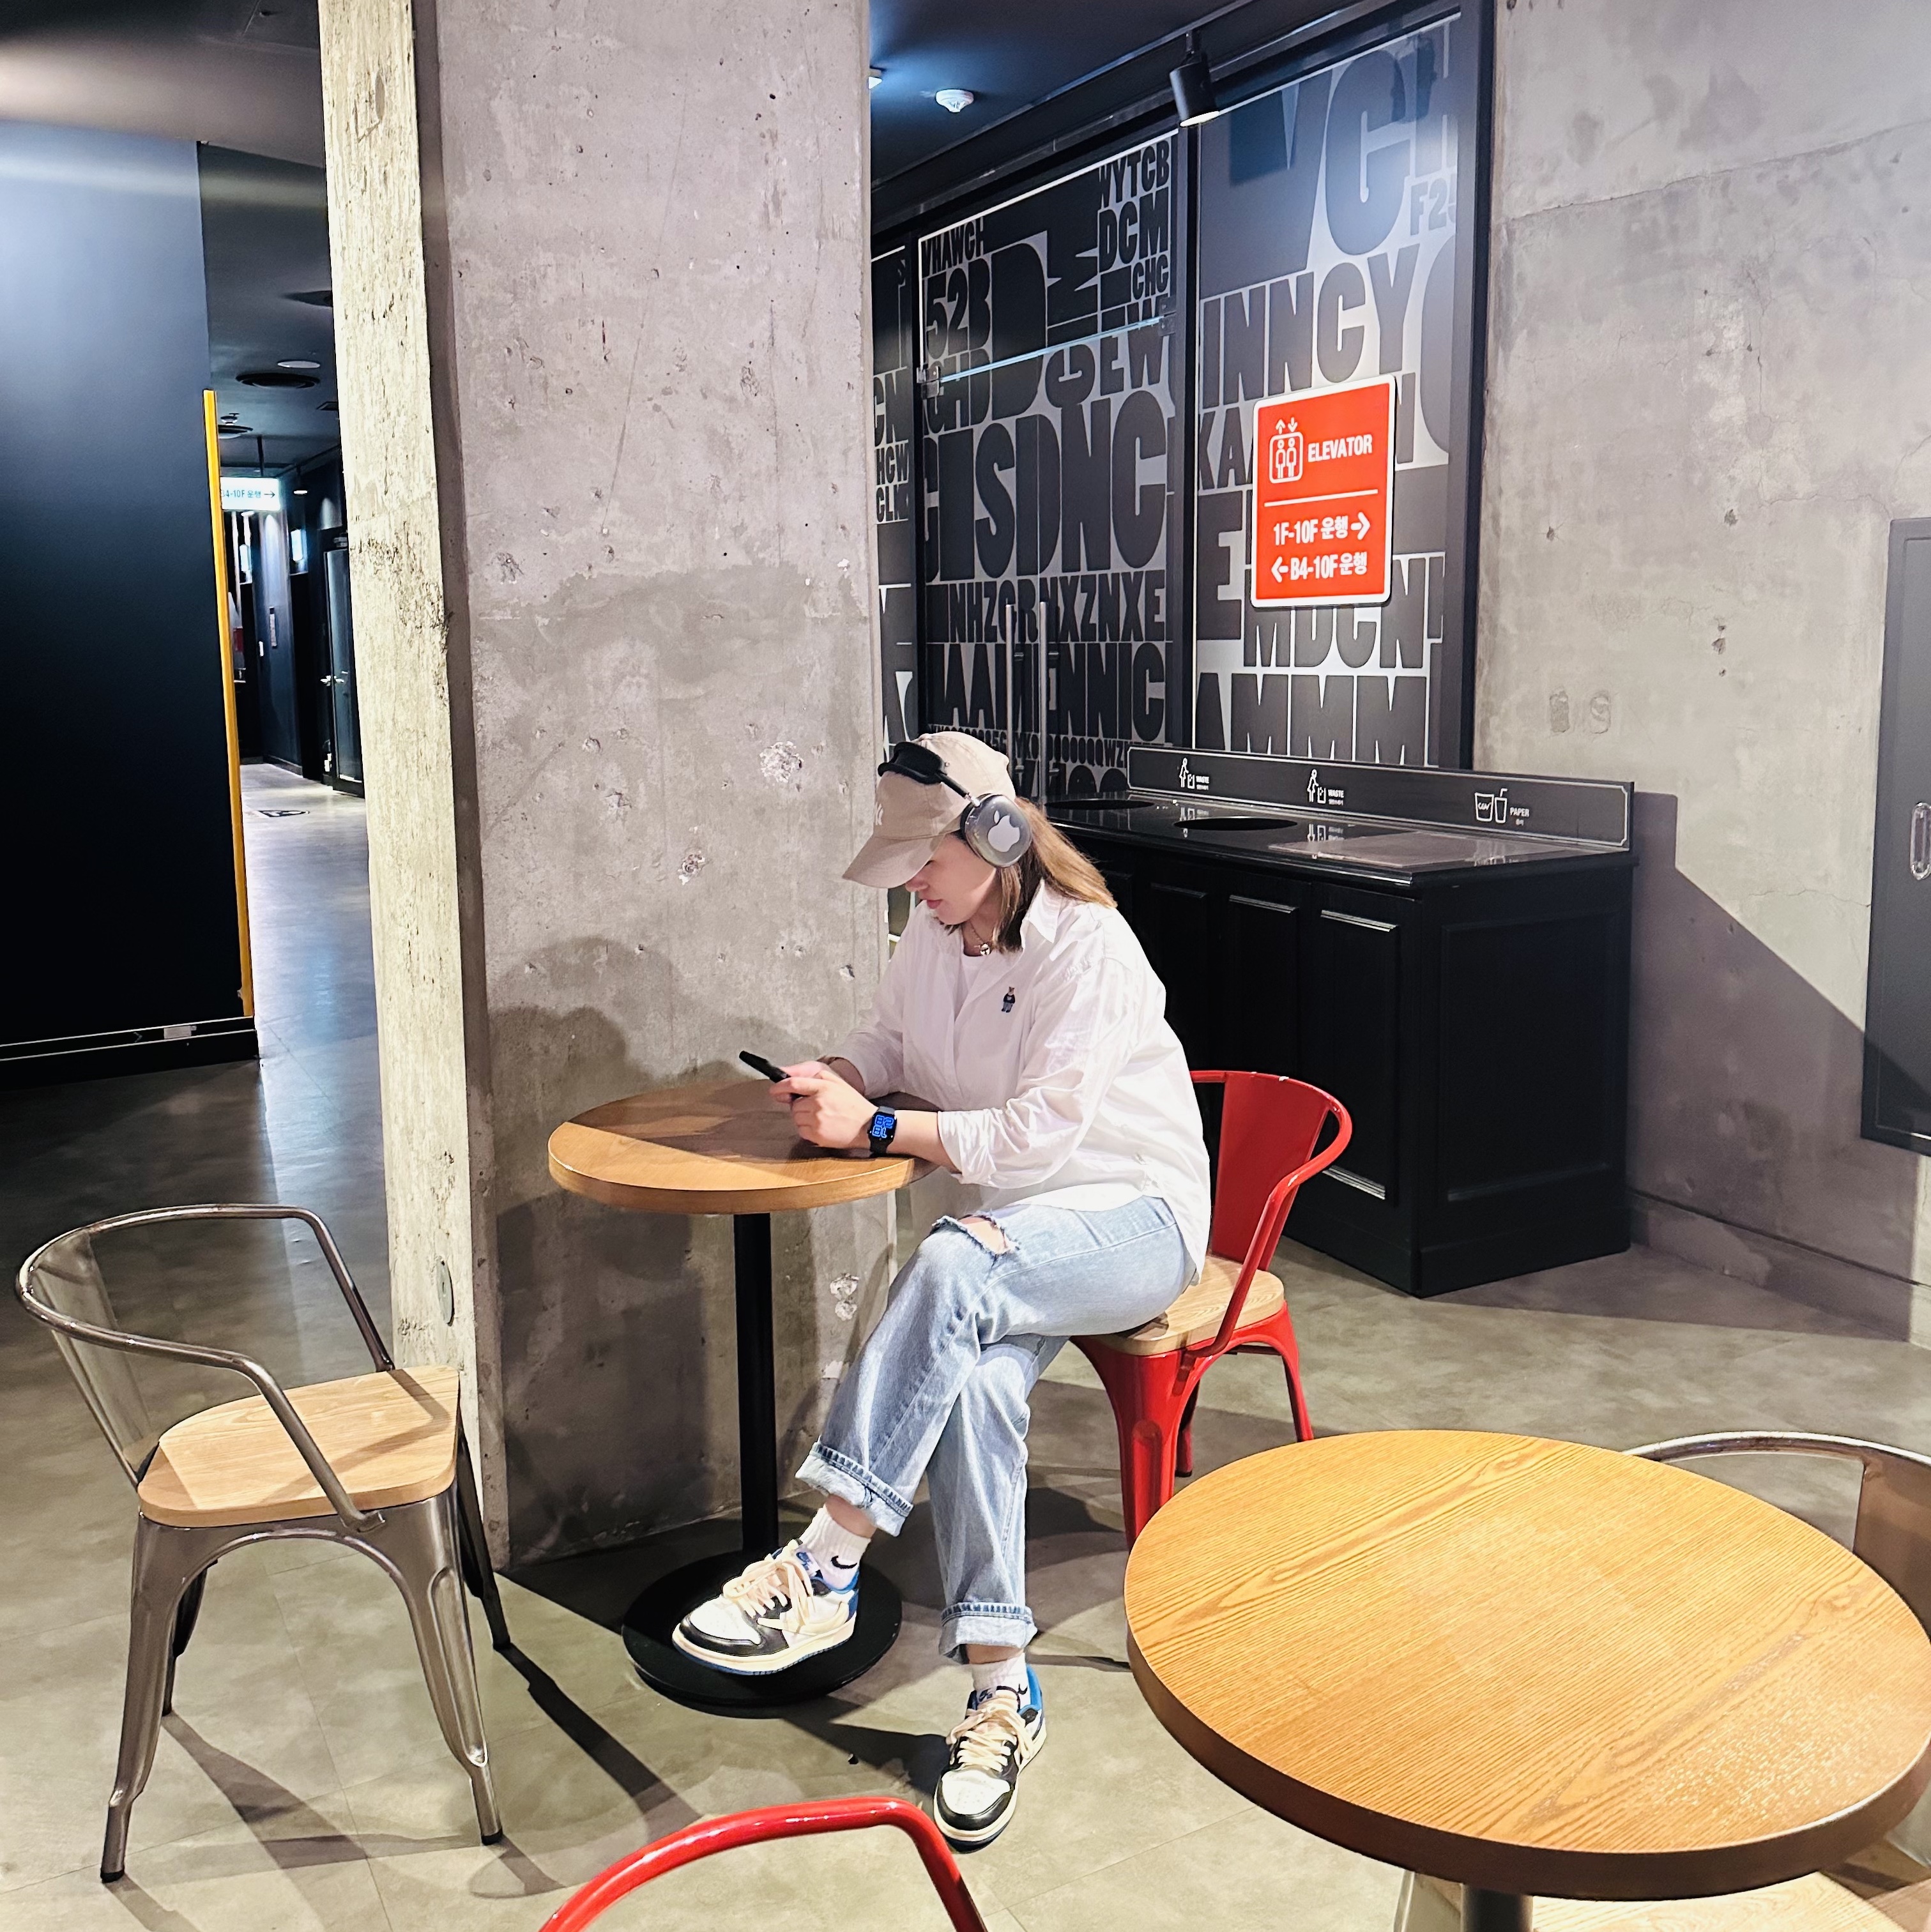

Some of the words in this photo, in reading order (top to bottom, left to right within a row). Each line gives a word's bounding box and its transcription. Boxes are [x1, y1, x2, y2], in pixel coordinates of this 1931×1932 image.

[1099, 188, 1169, 273] DCM
[1308, 434, 1373, 462] ELEVATOR
[1273, 519, 1318, 546] 1F-10F
[1320, 515, 1348, 540] 운행
[1290, 554, 1338, 581] B4-10F
[1339, 551, 1368, 575] 운행
[1328, 789, 1344, 798] WASTE
[1510, 807, 1529, 817] PAPER
